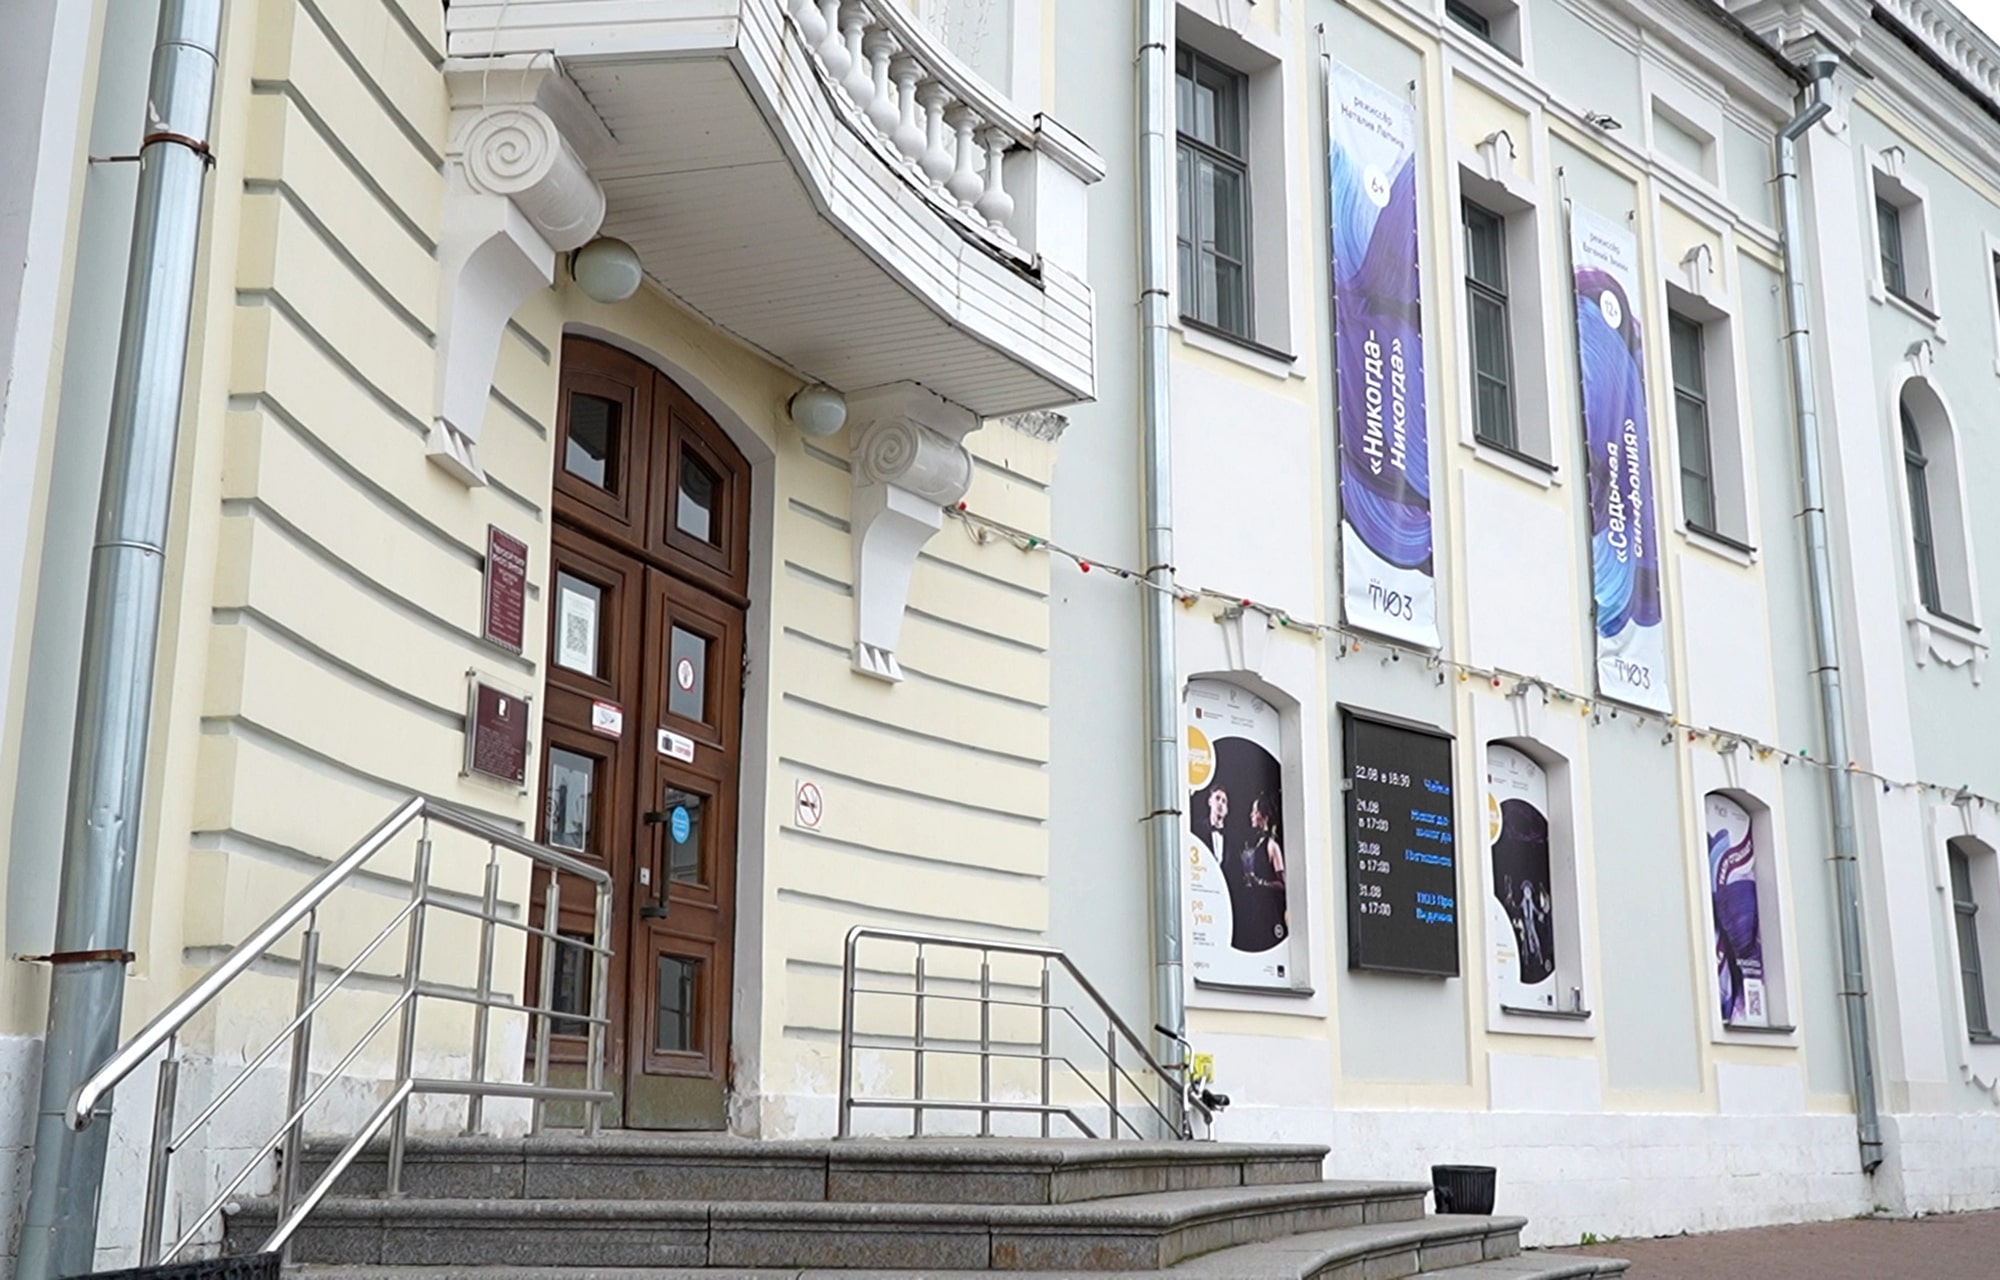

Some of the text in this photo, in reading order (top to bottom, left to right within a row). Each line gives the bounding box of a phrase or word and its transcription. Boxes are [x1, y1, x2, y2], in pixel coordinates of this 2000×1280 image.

[1371, 177, 1385, 194] 6+
[1362, 329, 1384, 476] «Никогда-
[1390, 338, 1406, 471] Никогда»
[1607, 441, 1628, 564] «Седьмая
[1623, 418, 1643, 558] симфония»
[1355, 765, 1378, 781] 22.08
[1368, 902, 1391, 917] 17:00
